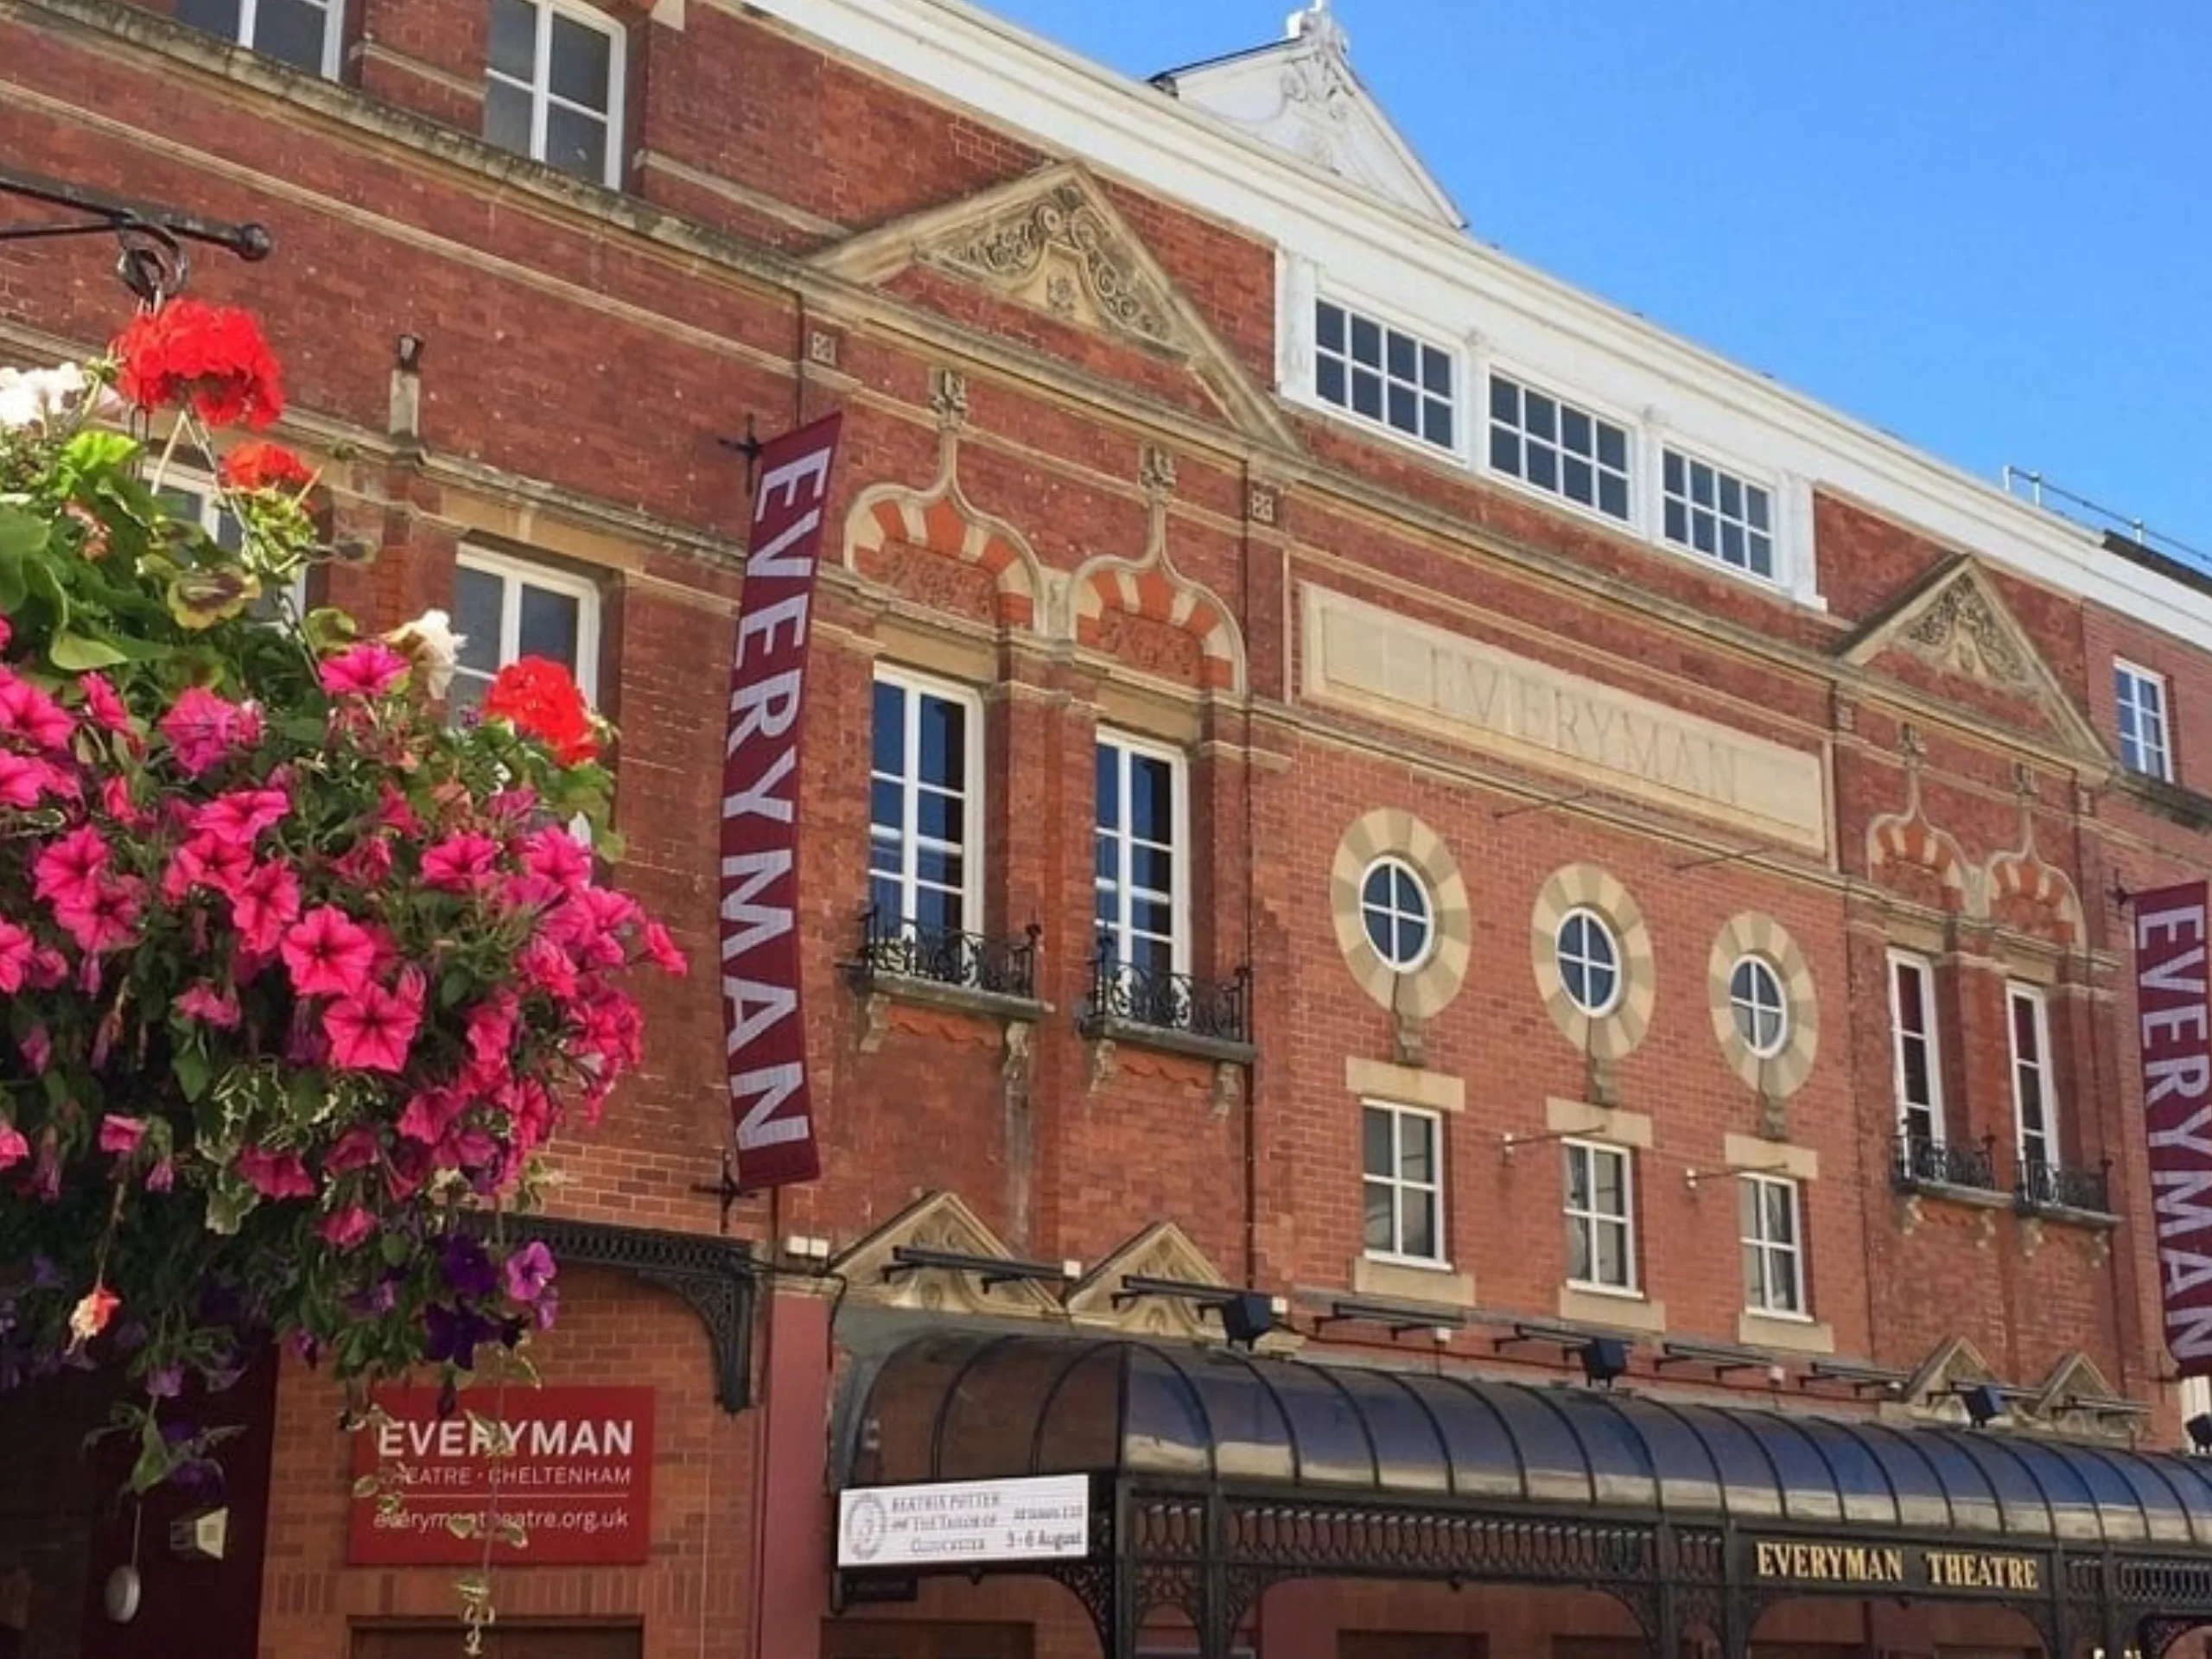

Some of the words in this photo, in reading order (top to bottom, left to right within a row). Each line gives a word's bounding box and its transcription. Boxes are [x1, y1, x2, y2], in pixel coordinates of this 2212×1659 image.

[1430, 646, 1738, 804] EVERYMAN
[721, 445, 830, 1151] EVERYMAN
[2138, 903, 2212, 1359] EVERYMAN
[378, 1466, 472, 1485] EATRE
[487, 1466, 631, 1485] CHELTENHAM
[950, 1491, 1001, 1510] POTTER
[1037, 1529, 1083, 1551] August
[1754, 1541, 1904, 1581] EVERYMAN
[1923, 1551, 2039, 1589] THEATRE
